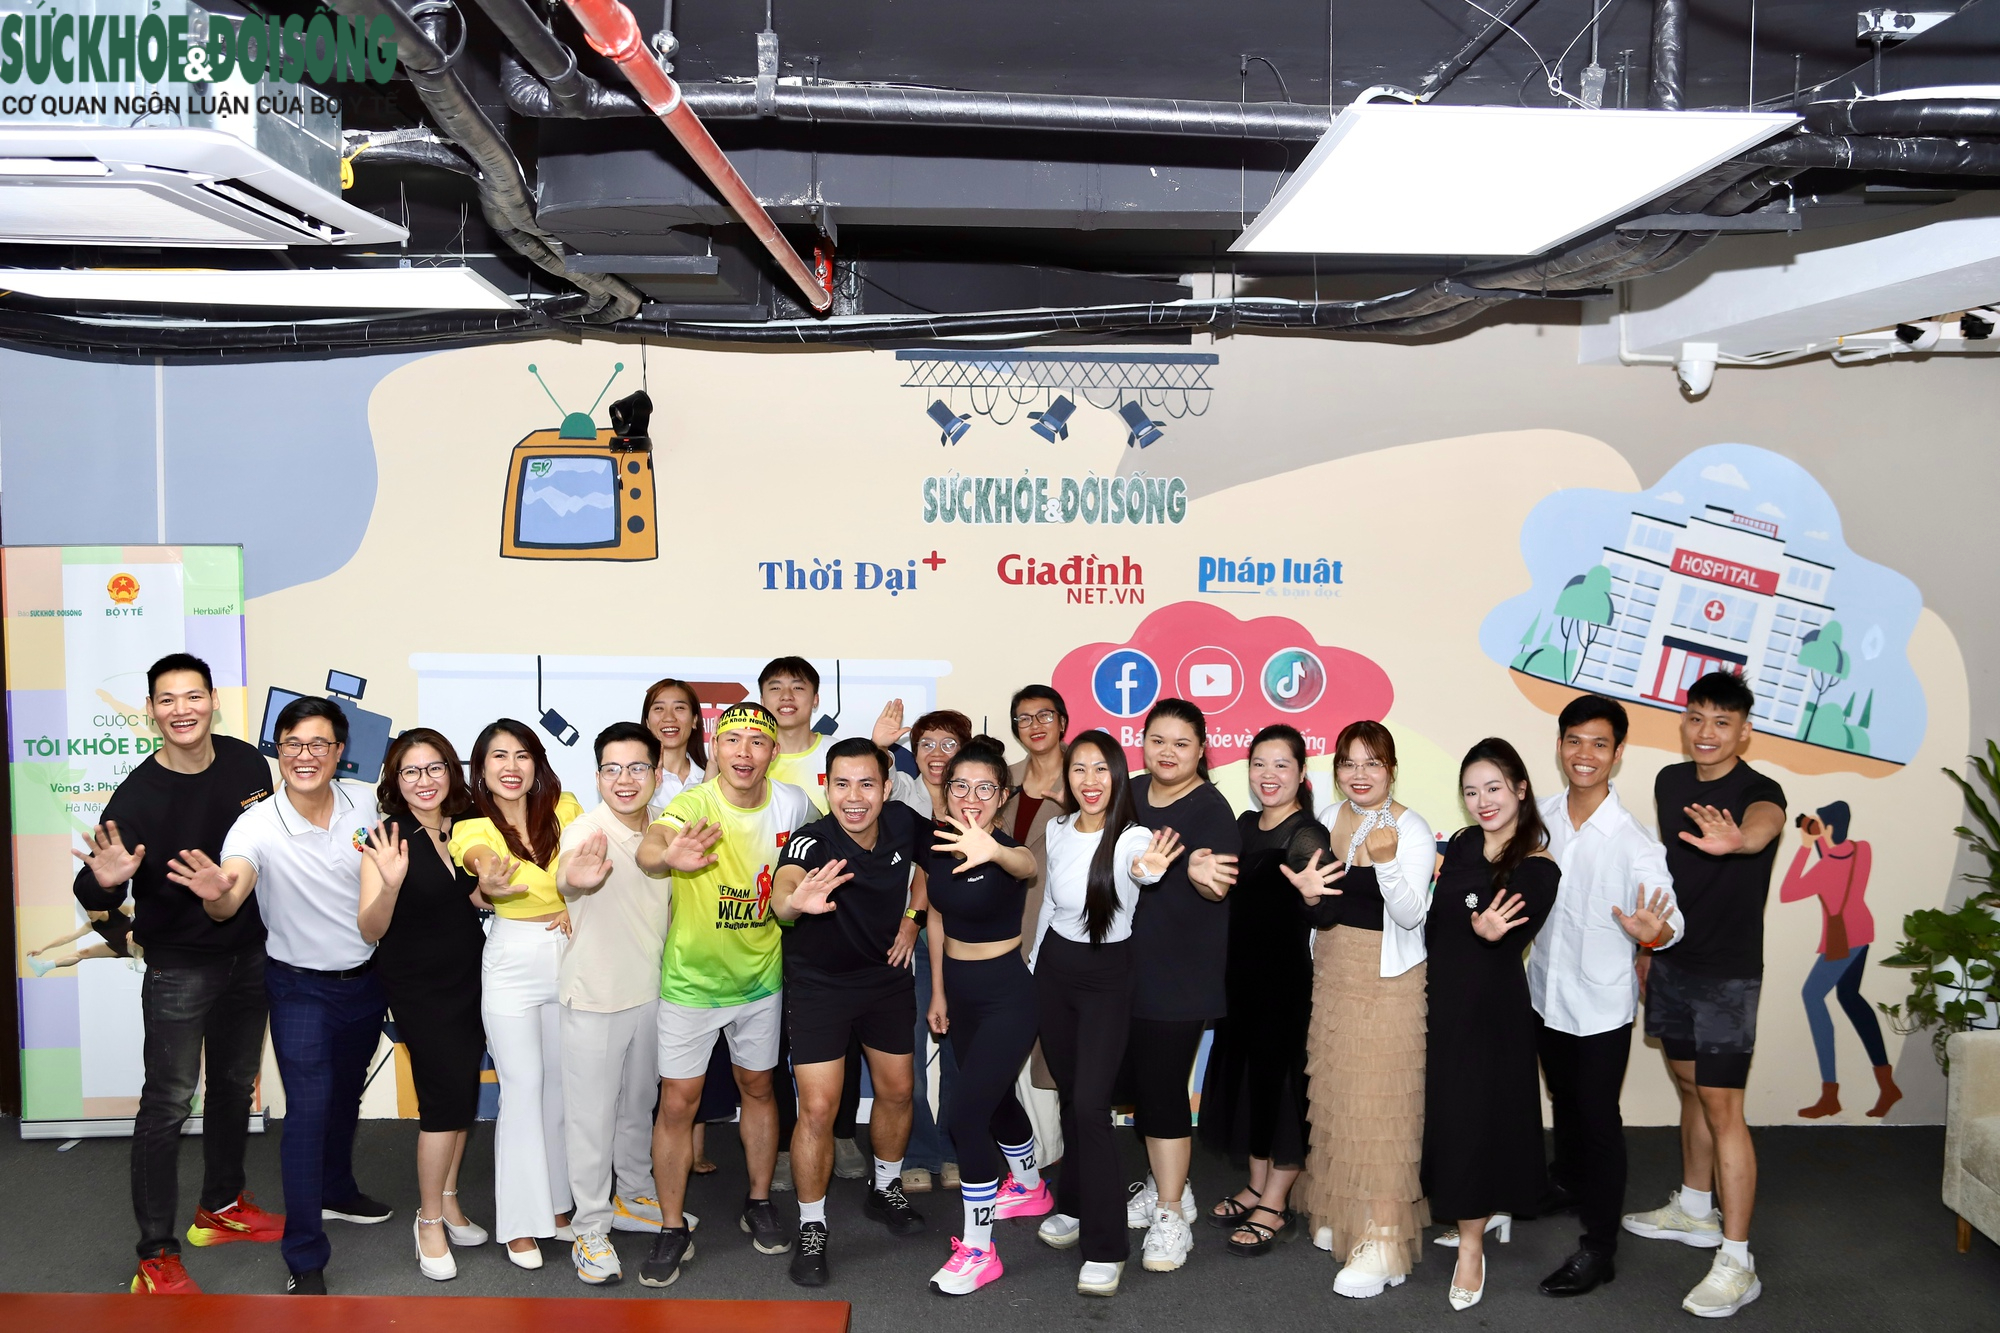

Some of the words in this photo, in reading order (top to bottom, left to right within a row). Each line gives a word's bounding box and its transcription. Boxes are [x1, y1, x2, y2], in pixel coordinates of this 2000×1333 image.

[758, 557, 843, 590] Thời
[1198, 556, 1276, 592] Pháp
[1282, 557, 1343, 587] luật
[1680, 554, 1759, 588] HOSPITAL
[1067, 588, 1144, 604] NET.VN
[105, 608, 120, 618] BỘ
[131, 606, 143, 616] TẾ
[193, 606, 231, 615] Herbalife
[93, 712, 139, 729] CUỘC
[23, 735, 60, 757] TÔI
[67, 733, 129, 755] KHỎE
[135, 737, 164, 754] ĐE
[1121, 726, 1144, 747] Bá
[50, 783, 80, 794] Vòng
[84, 783, 95, 791] 3:
[97, 782, 119, 791] Phỏ
[65, 803, 80, 812] Hà
